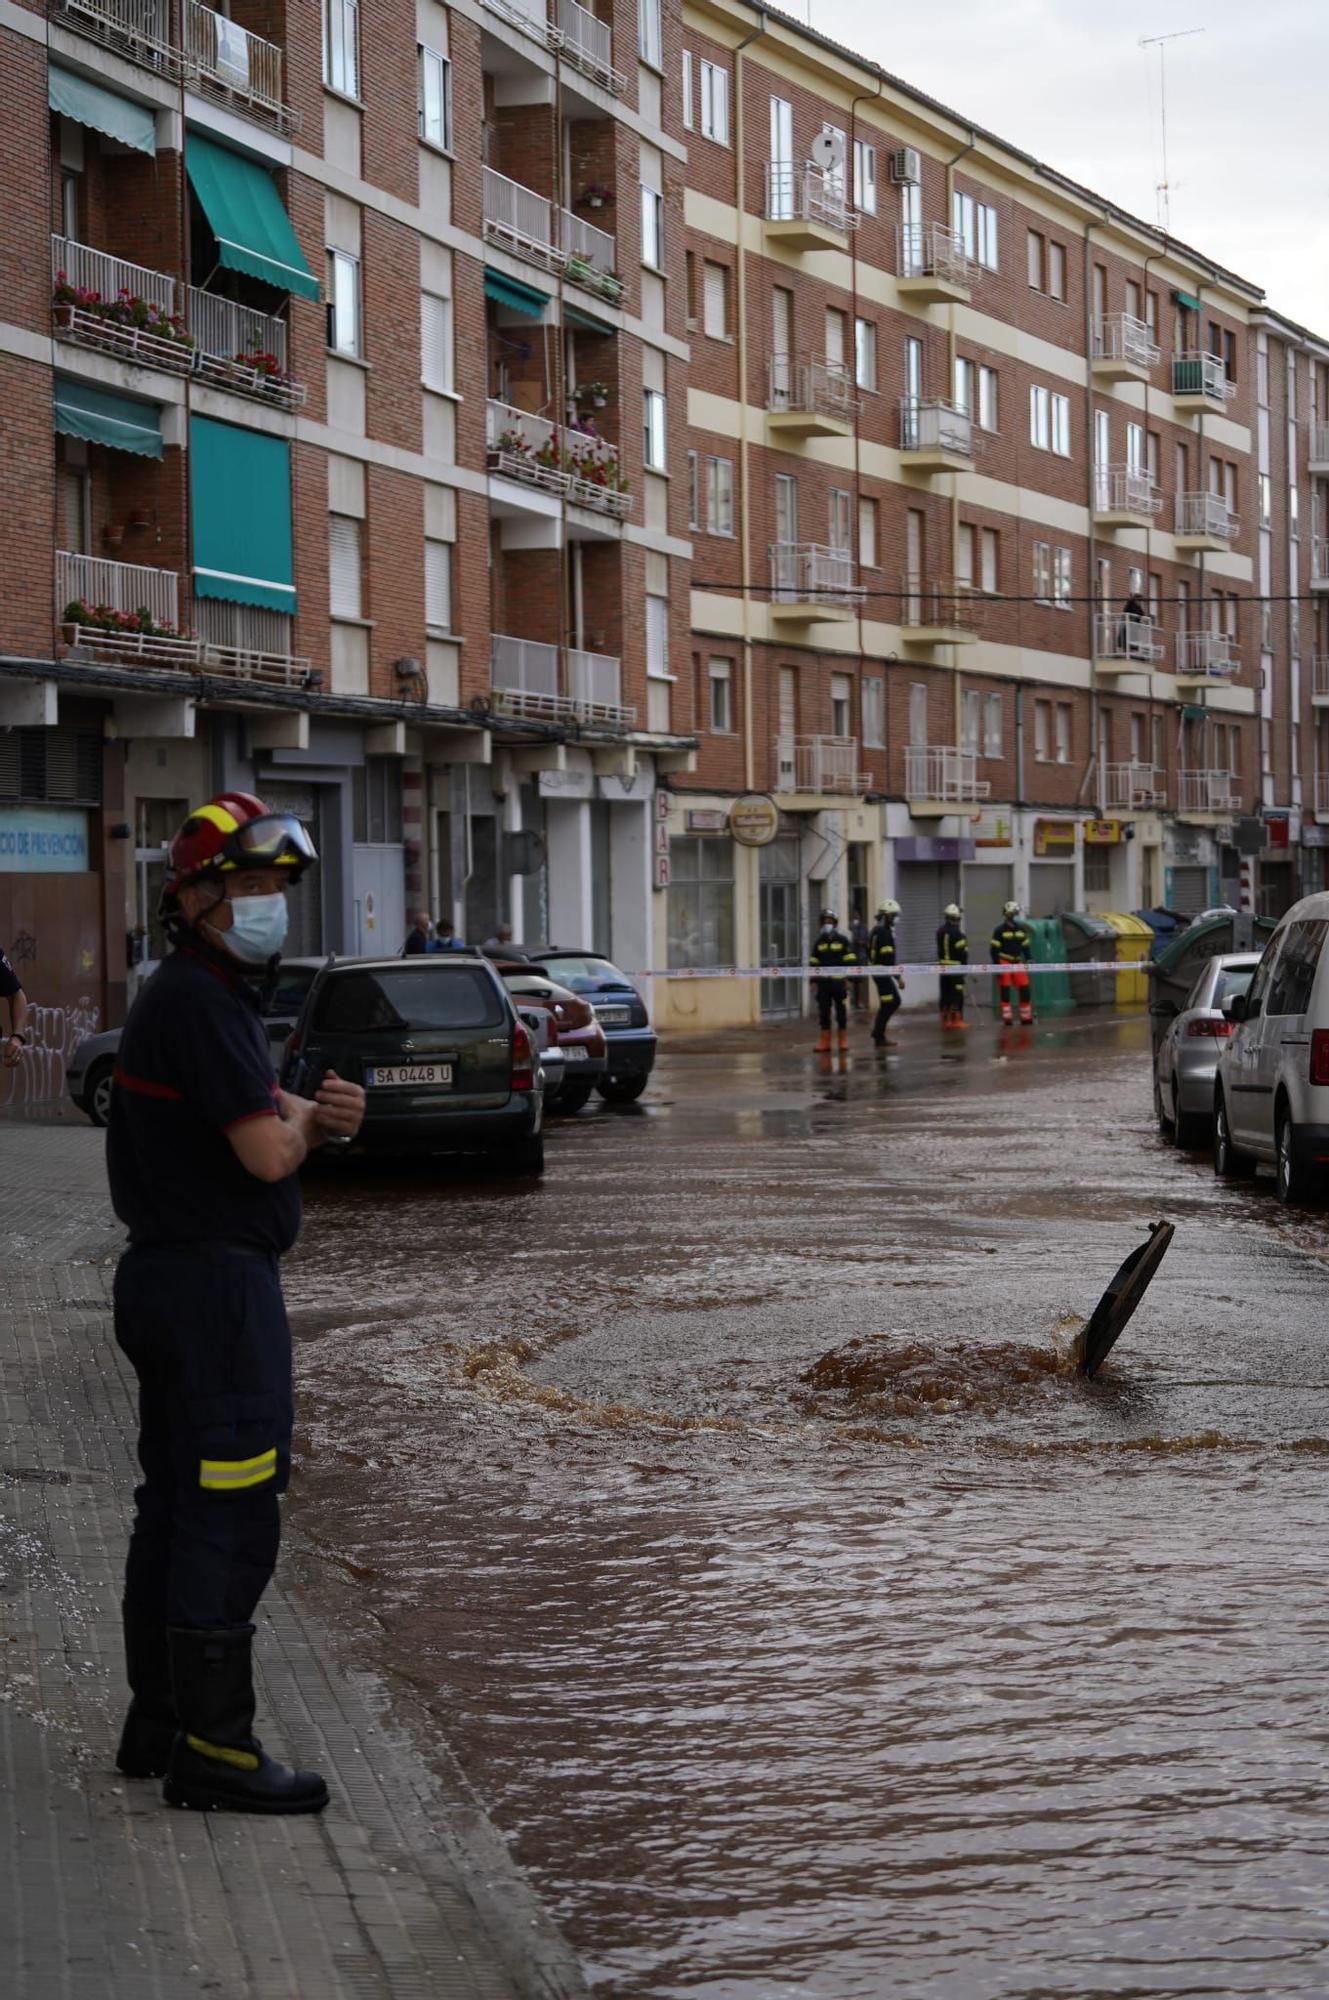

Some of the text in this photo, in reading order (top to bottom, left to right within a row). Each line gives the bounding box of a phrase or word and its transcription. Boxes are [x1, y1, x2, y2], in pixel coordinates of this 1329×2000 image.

[18, 831, 30, 855] DE
[658, 792, 669, 884] BAR
[376, 1066, 450, 1083] SA 0448 U
